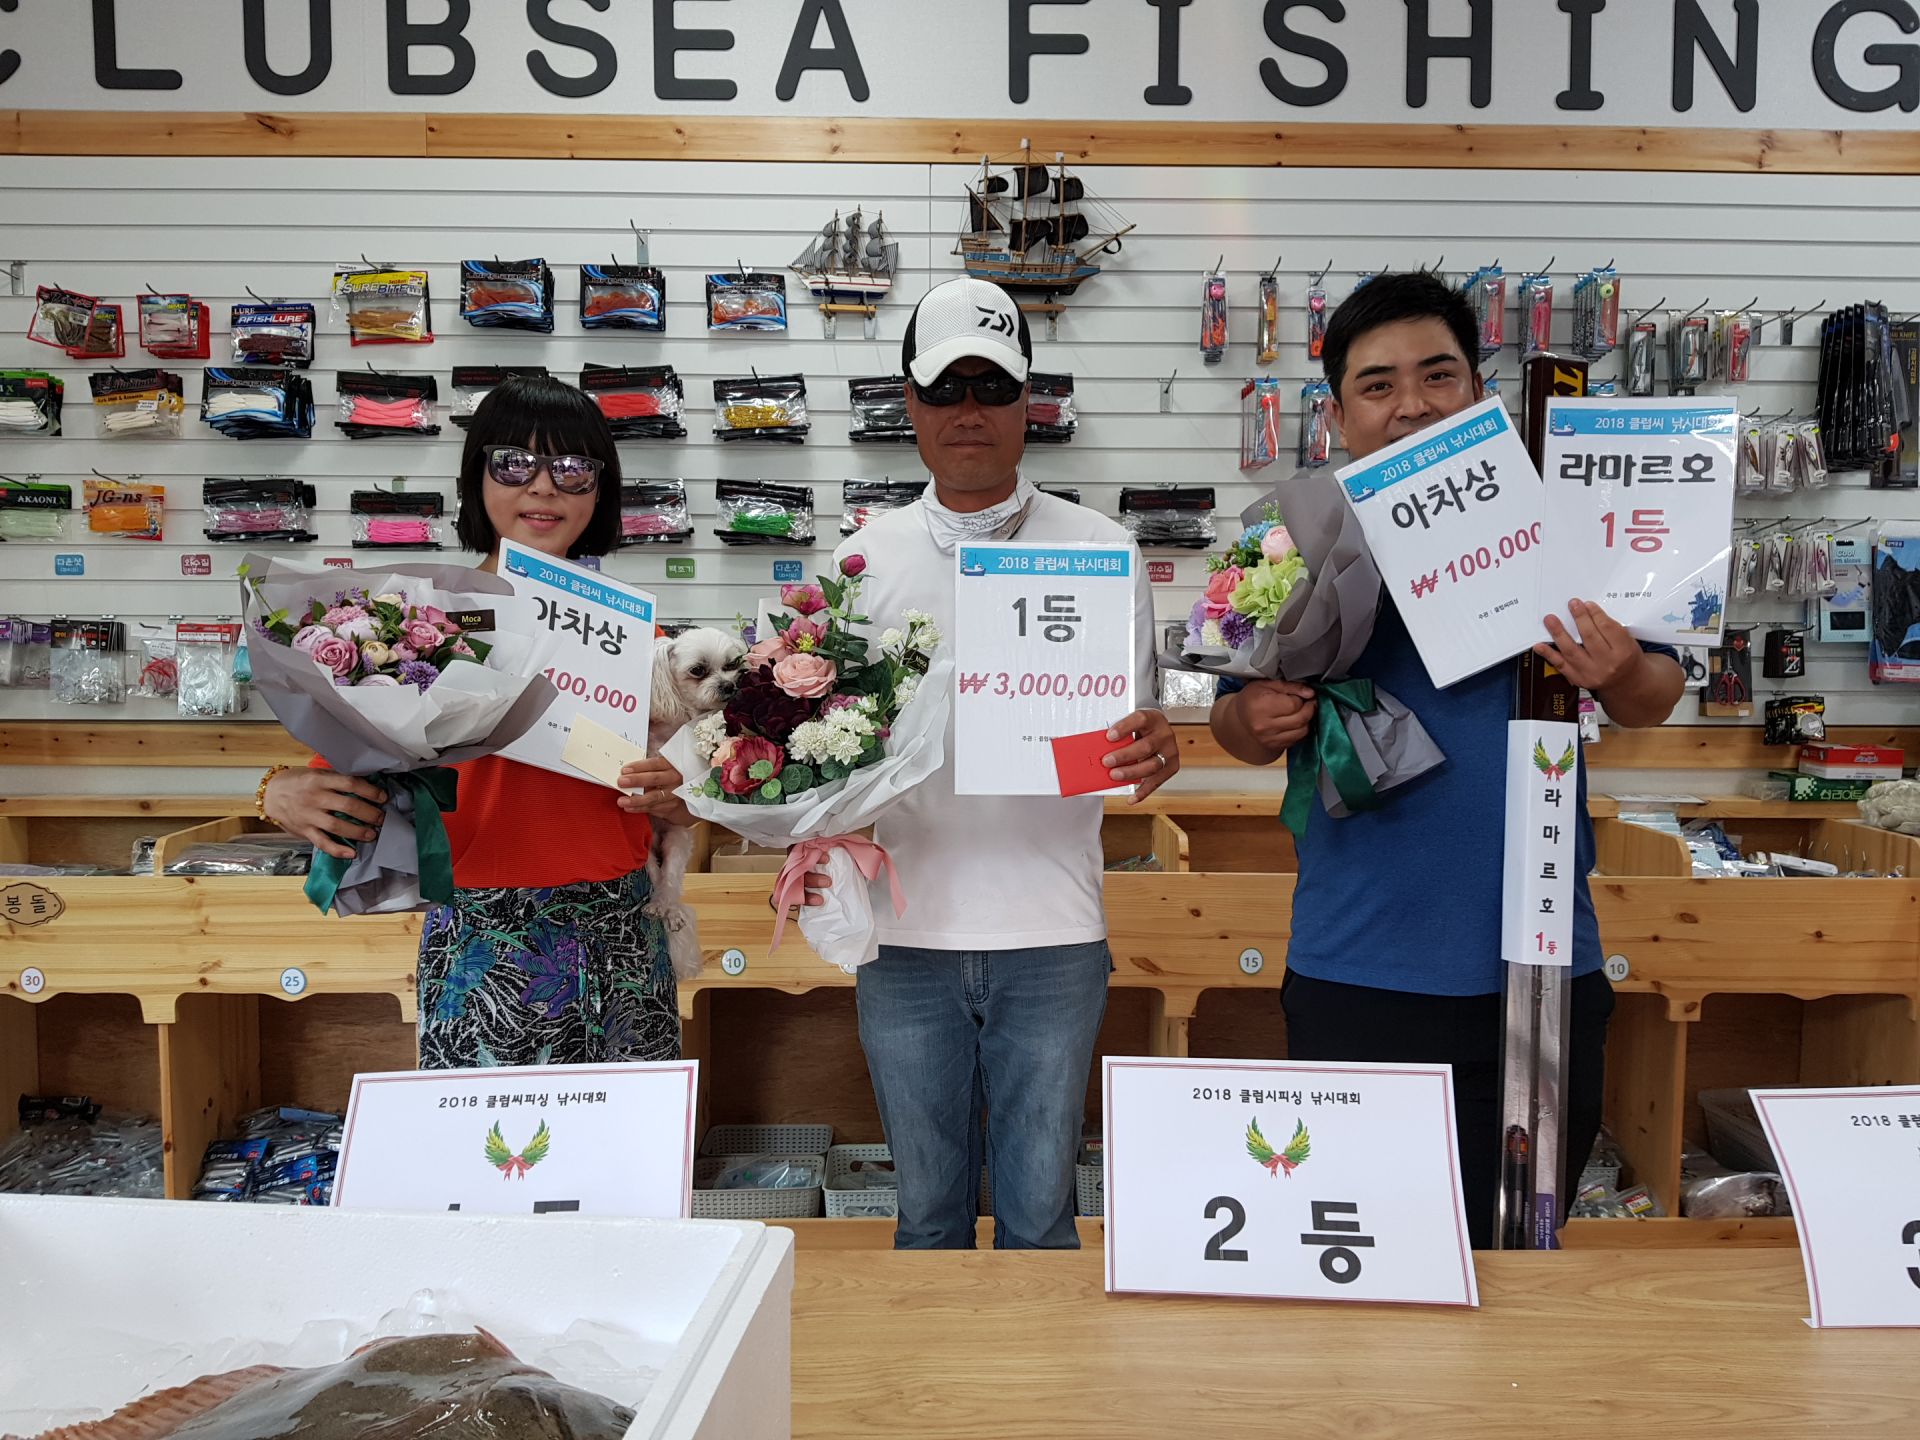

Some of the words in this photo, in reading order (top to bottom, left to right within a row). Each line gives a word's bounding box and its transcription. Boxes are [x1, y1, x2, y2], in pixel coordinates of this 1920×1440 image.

[1008, 0, 1920, 114] FISHING
[1593, 417, 1624, 429] 2018
[1380, 459, 1411, 482] 2018
[1450, 417, 1498, 449] 낚시대회
[1559, 453, 1716, 488] 라마르호
[1391, 459, 1500, 530] 아차상
[1600, 509, 1670, 553] 1등
[998, 556, 1029, 569] 2018
[1073, 557, 1122, 572] 낚시대회
[539, 567, 567, 586] 2018
[605, 591, 646, 616] 낚시대회
[461, 615, 482, 623] Moca
[1012, 595, 1082, 643] 1등
[993, 672, 1127, 700] 3,000,000
[1535, 931, 1558, 955] 1등
[726, 956, 742, 969] 10
[1244, 956, 1259, 968] 15
[1609, 963, 1626, 975] 10
[24, 975, 41, 987] 30
[284, 976, 300, 987] 25
[439, 1096, 478, 1109] 2018
[485, 1093, 549, 1109] 클럽씨피싱
[556, 1091, 607, 1105] 낚시대회
[1193, 1087, 1232, 1101] 2018
[1239, 1089, 1303, 1105] 클럽시피싱
[1310, 1091, 1361, 1106] 낚시대회
[1851, 1114, 1891, 1127] 2018
[1203, 1195, 1249, 1262] 2
[1300, 1200, 1375, 1284] 등
